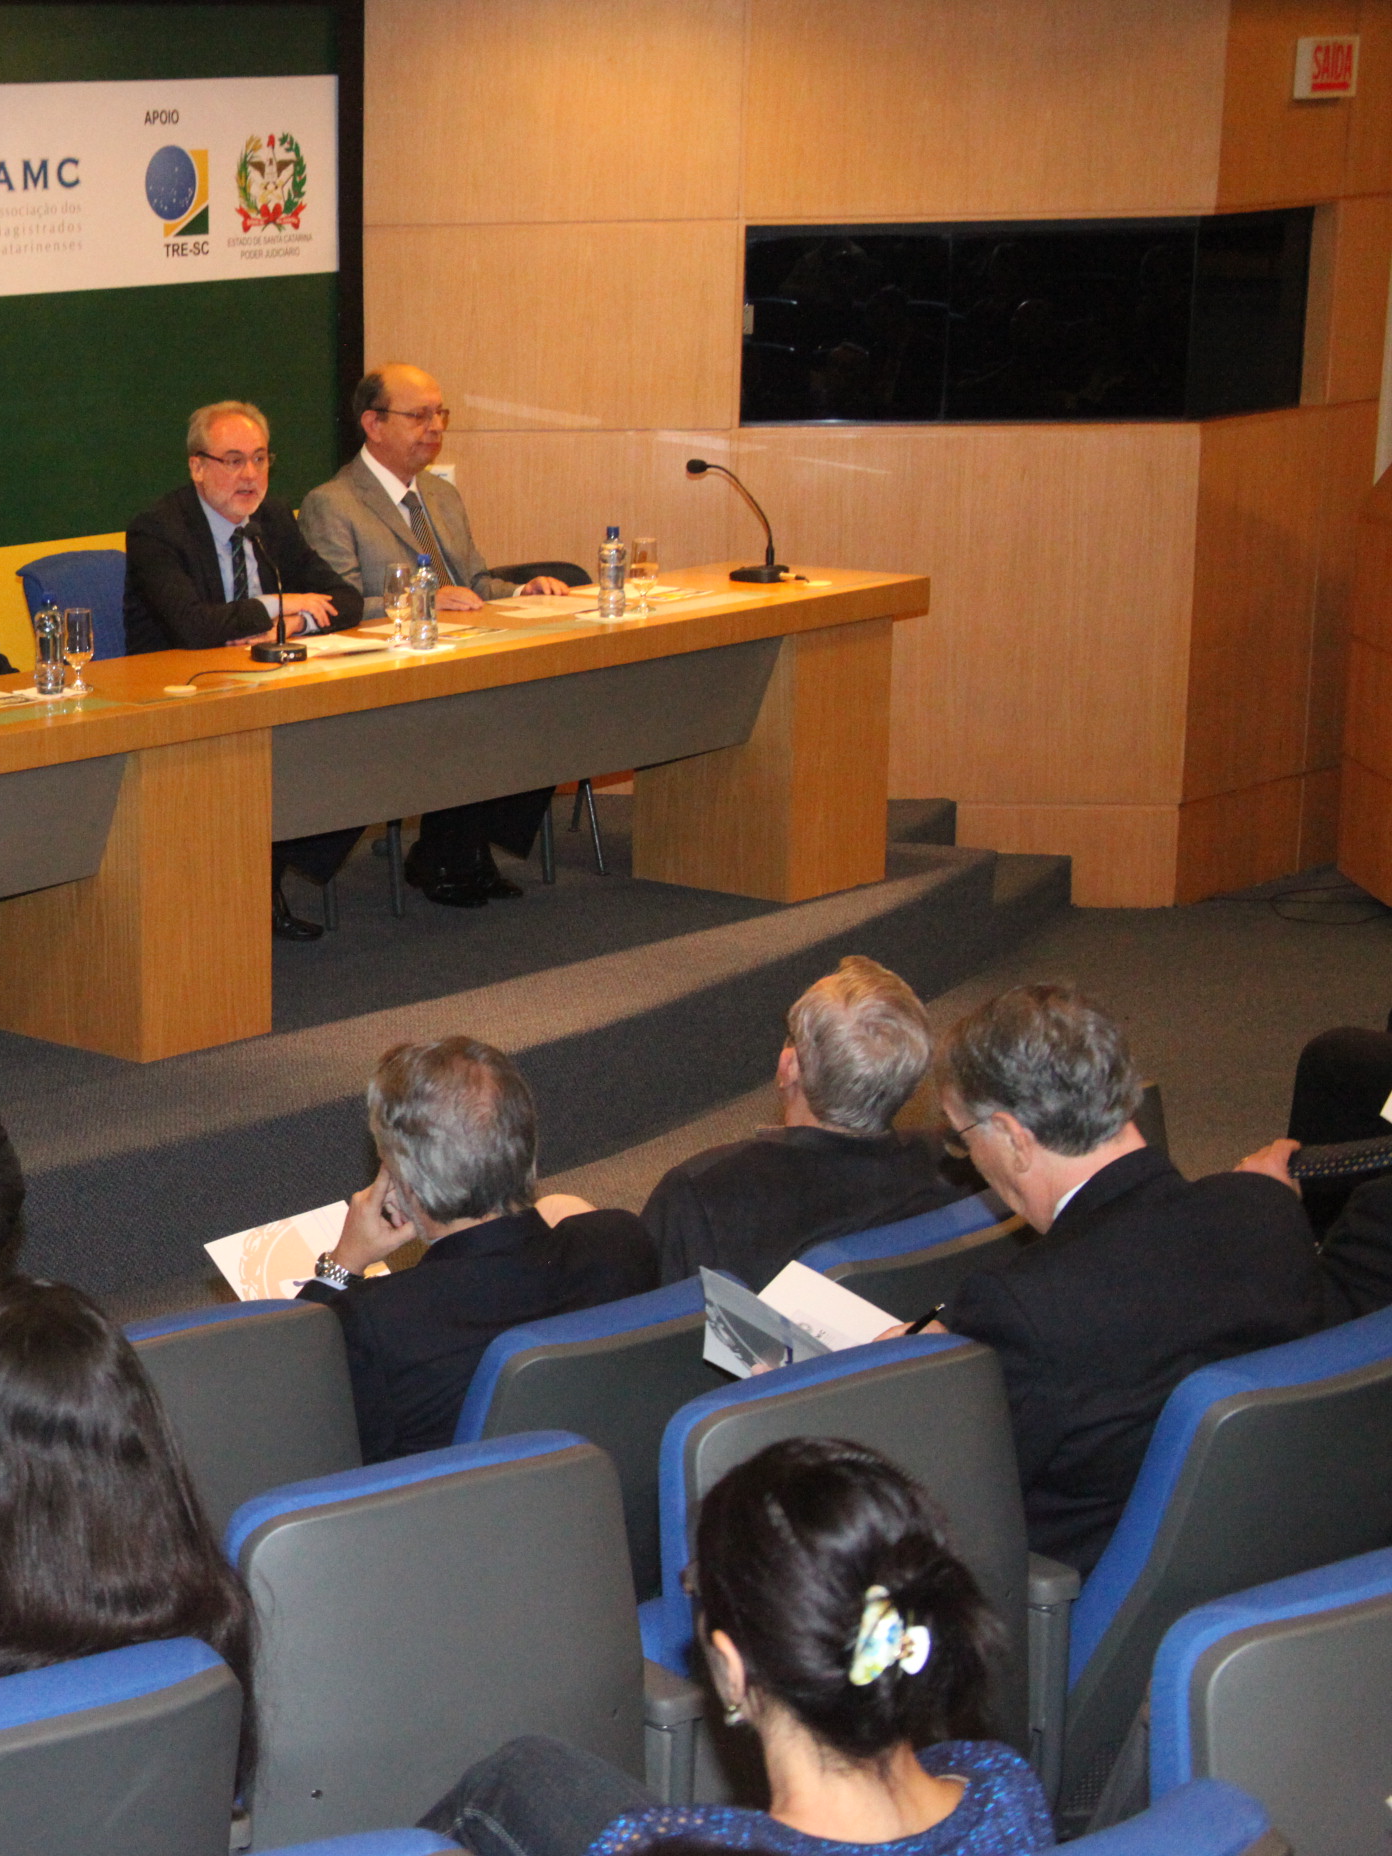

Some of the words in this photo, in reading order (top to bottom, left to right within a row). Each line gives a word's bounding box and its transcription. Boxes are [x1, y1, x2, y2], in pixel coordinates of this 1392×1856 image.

[144, 109, 179, 125] APOIO
[61, 201, 82, 214] dos
[164, 241, 209, 258] TRE-SC
